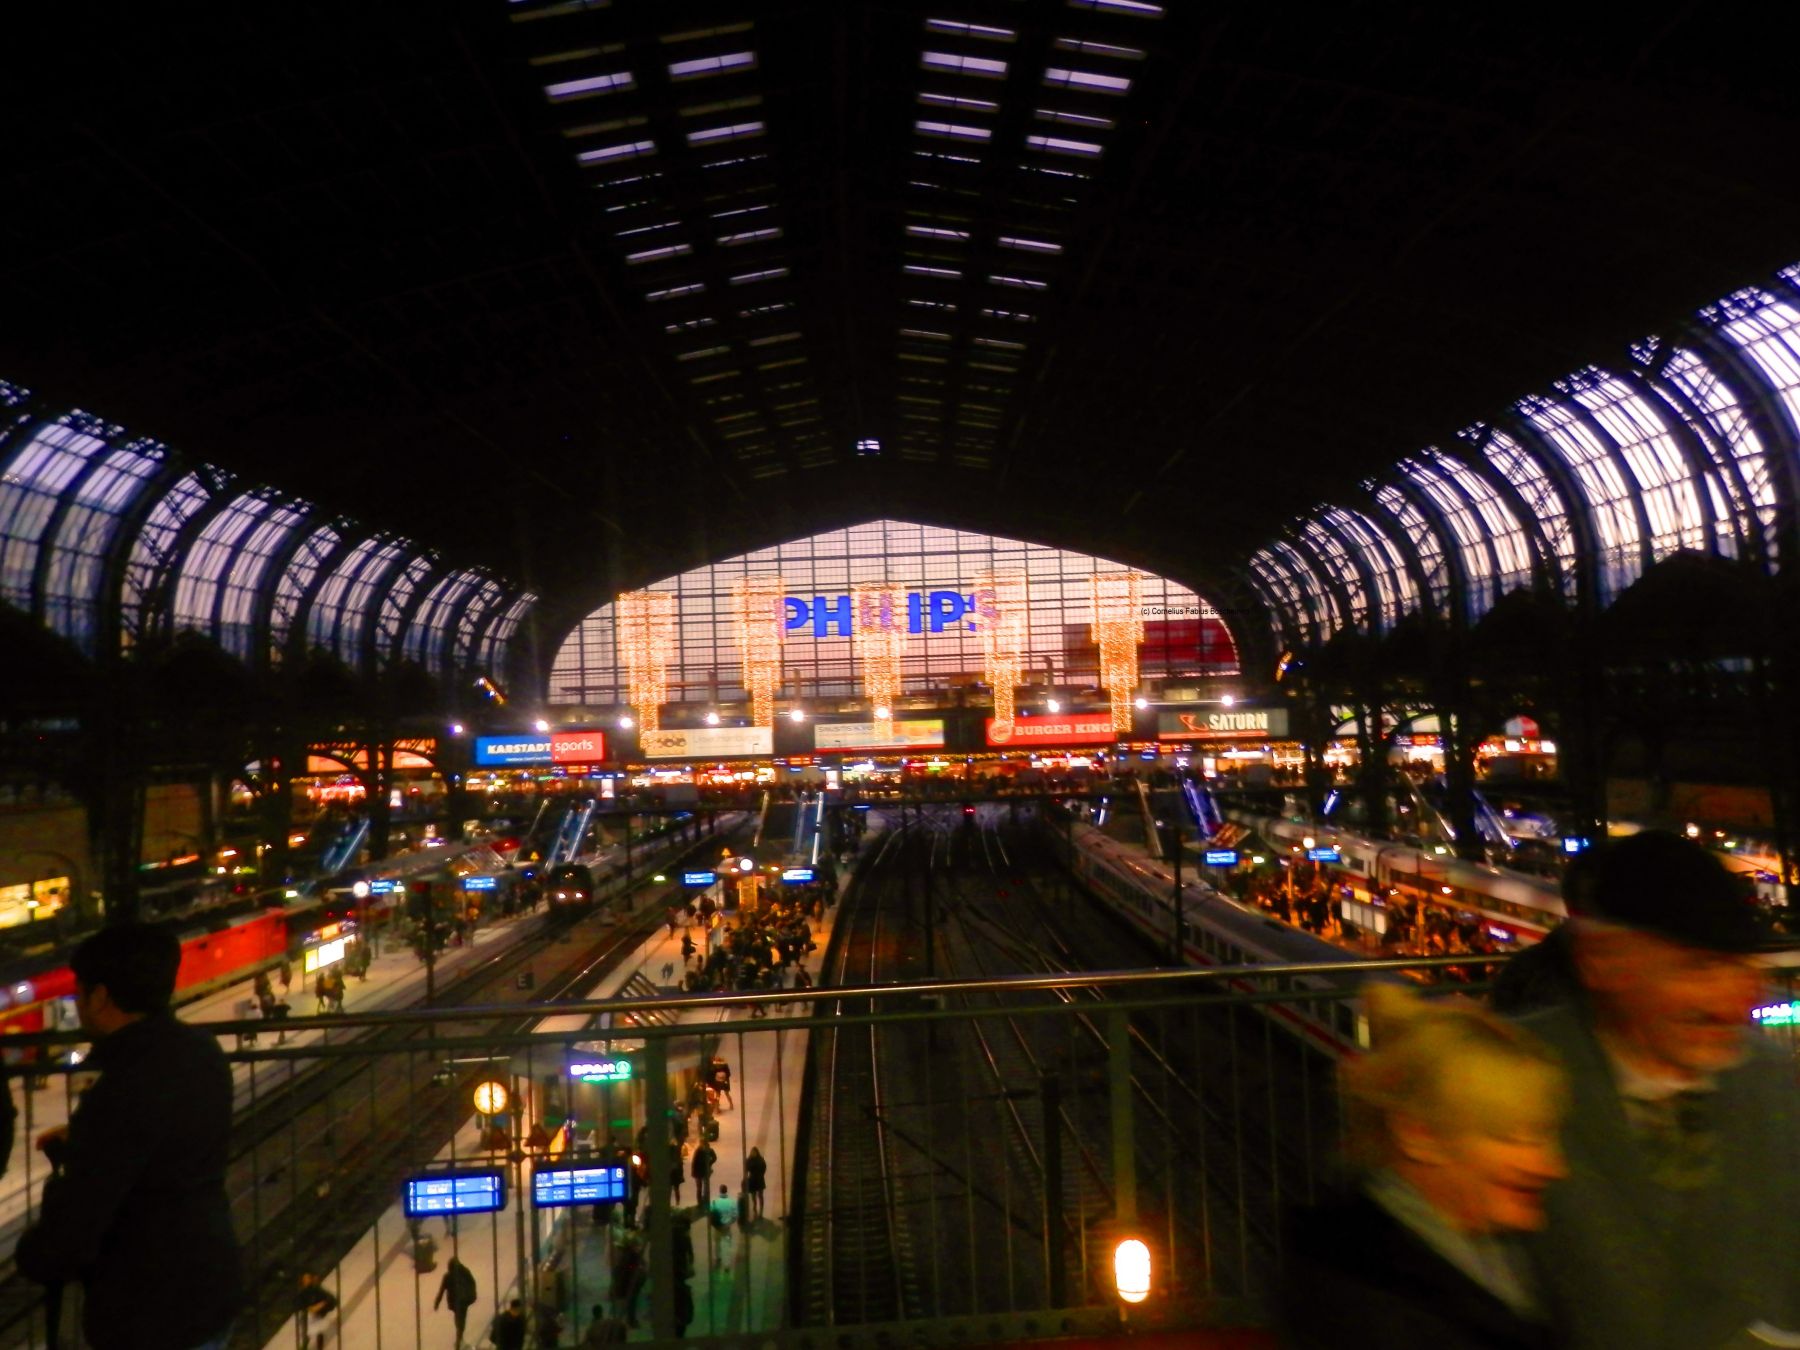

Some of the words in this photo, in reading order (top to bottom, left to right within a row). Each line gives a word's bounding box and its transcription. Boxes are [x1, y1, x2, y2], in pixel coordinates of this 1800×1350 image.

[774, 590, 1000, 638] PHILIPS
[1015, 724, 1072, 736] BURGER
[1075, 722, 1112, 734] KING
[1208, 712, 1268, 730] SATURN
[487, 743, 552, 755] KARSTADT
[554, 740, 593, 755] sports
